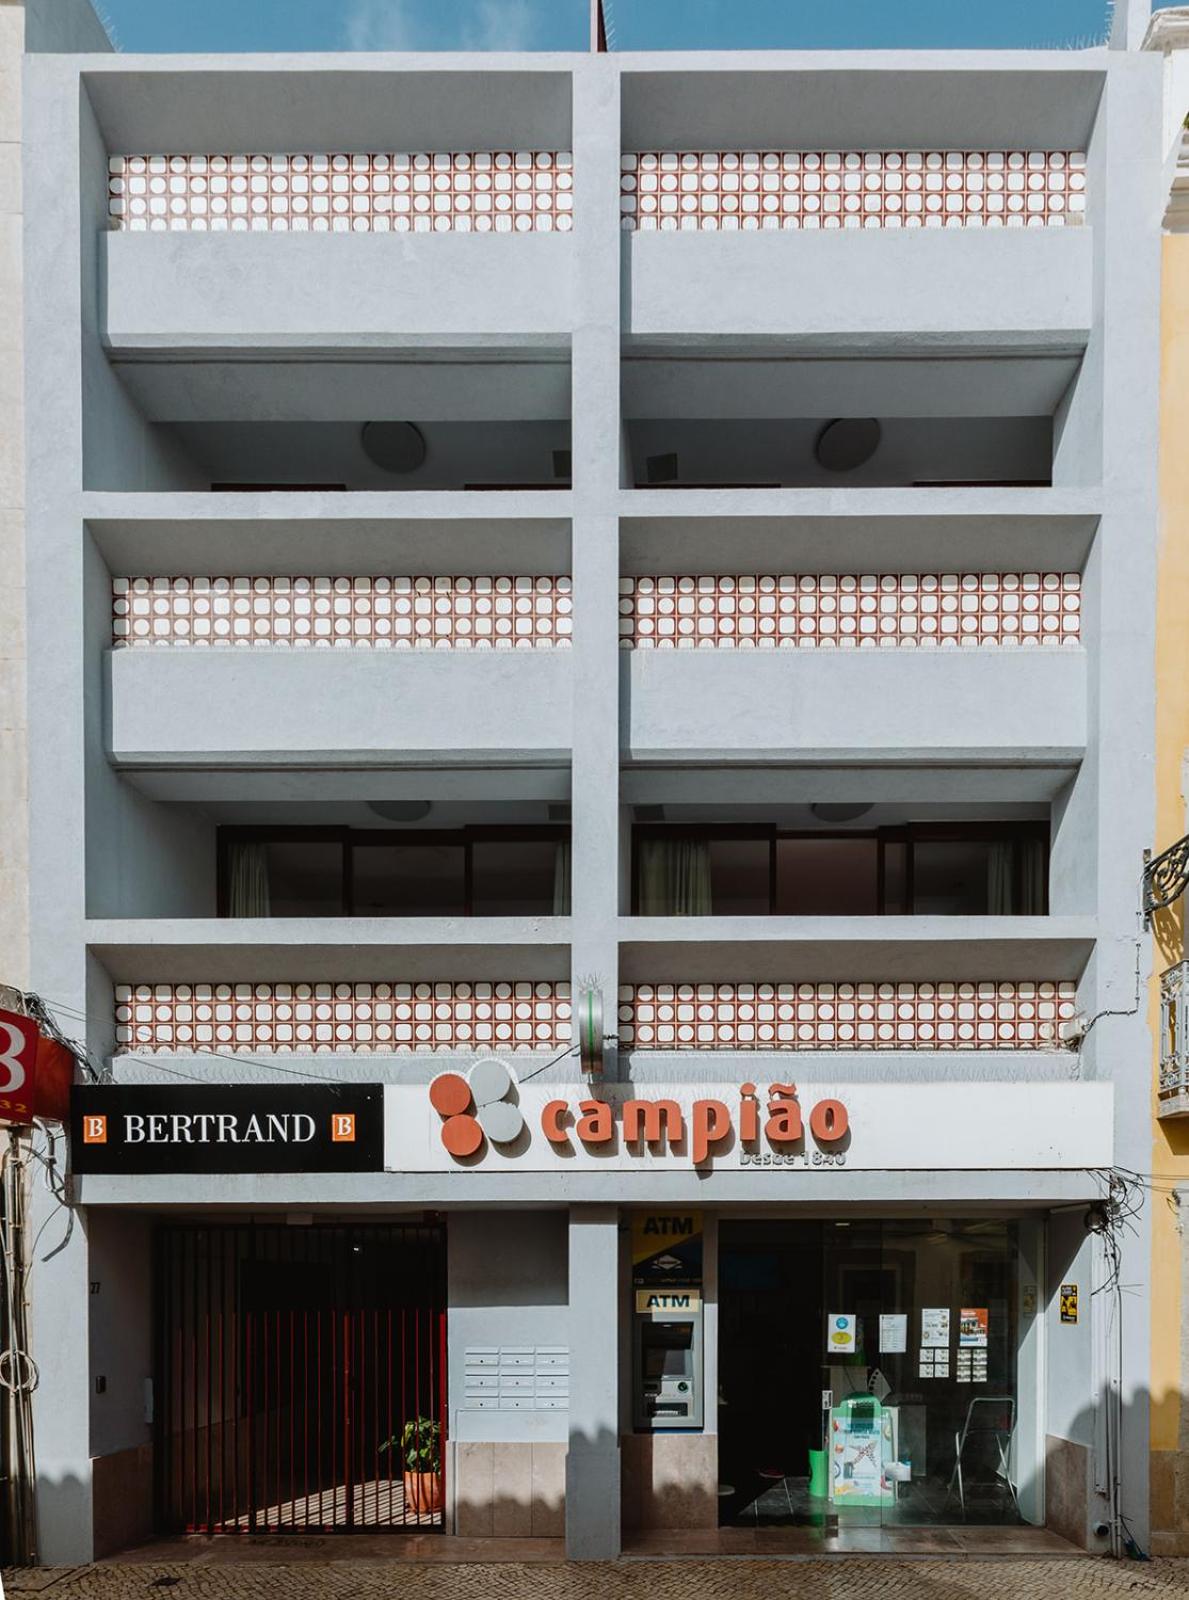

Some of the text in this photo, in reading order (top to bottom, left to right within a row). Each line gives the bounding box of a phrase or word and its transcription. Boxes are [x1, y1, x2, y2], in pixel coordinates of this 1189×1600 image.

[88, 1114, 352, 1143] B BERTRAND B
[540, 1081, 849, 1165] campião
[740, 1150, 795, 1166] Desde
[643, 1216, 693, 1235] ATM
[646, 1294, 690, 1308] ATM
